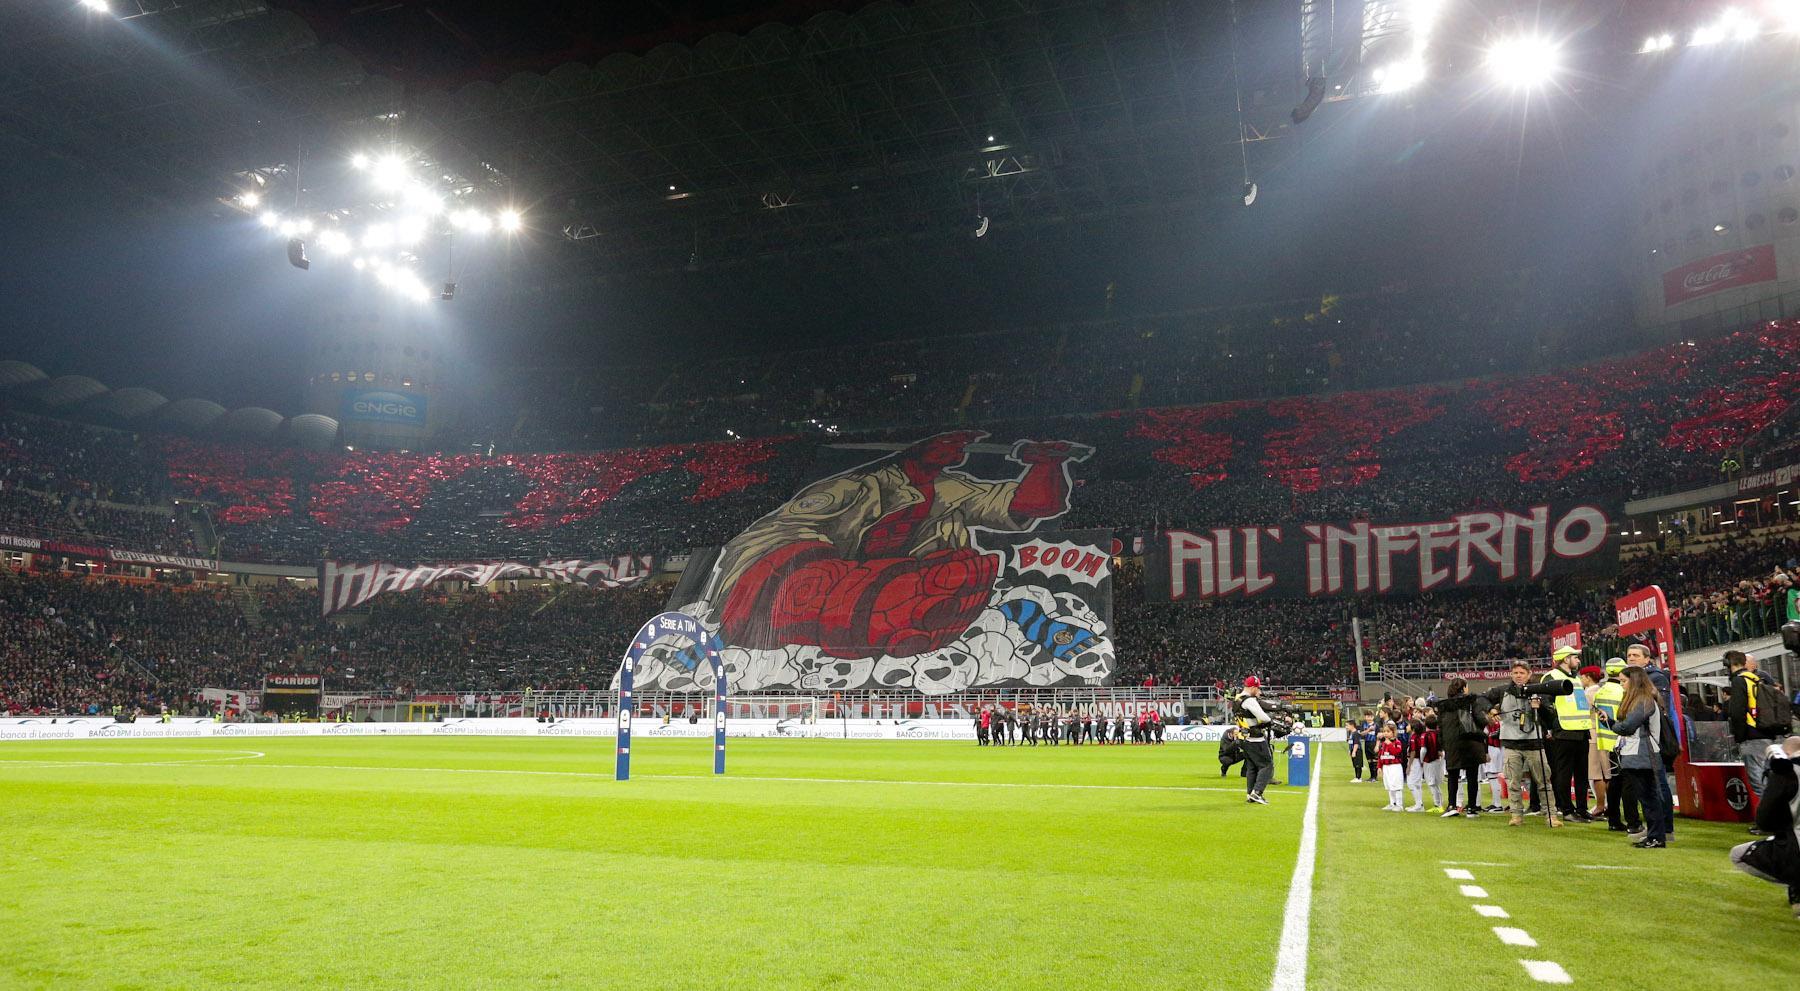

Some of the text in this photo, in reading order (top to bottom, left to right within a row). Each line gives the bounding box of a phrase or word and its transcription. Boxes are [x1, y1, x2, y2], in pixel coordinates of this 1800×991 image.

[1018, 545, 1106, 578] BOOM
[1617, 605, 1640, 626] Emirates
[677, 619, 683, 631] A
[684, 620, 696, 632] TIM
[275, 677, 319, 685] CARUGO
[0, 730, 74, 739] banca di Leonardo
[1166, 732, 1203, 741] BANCO
